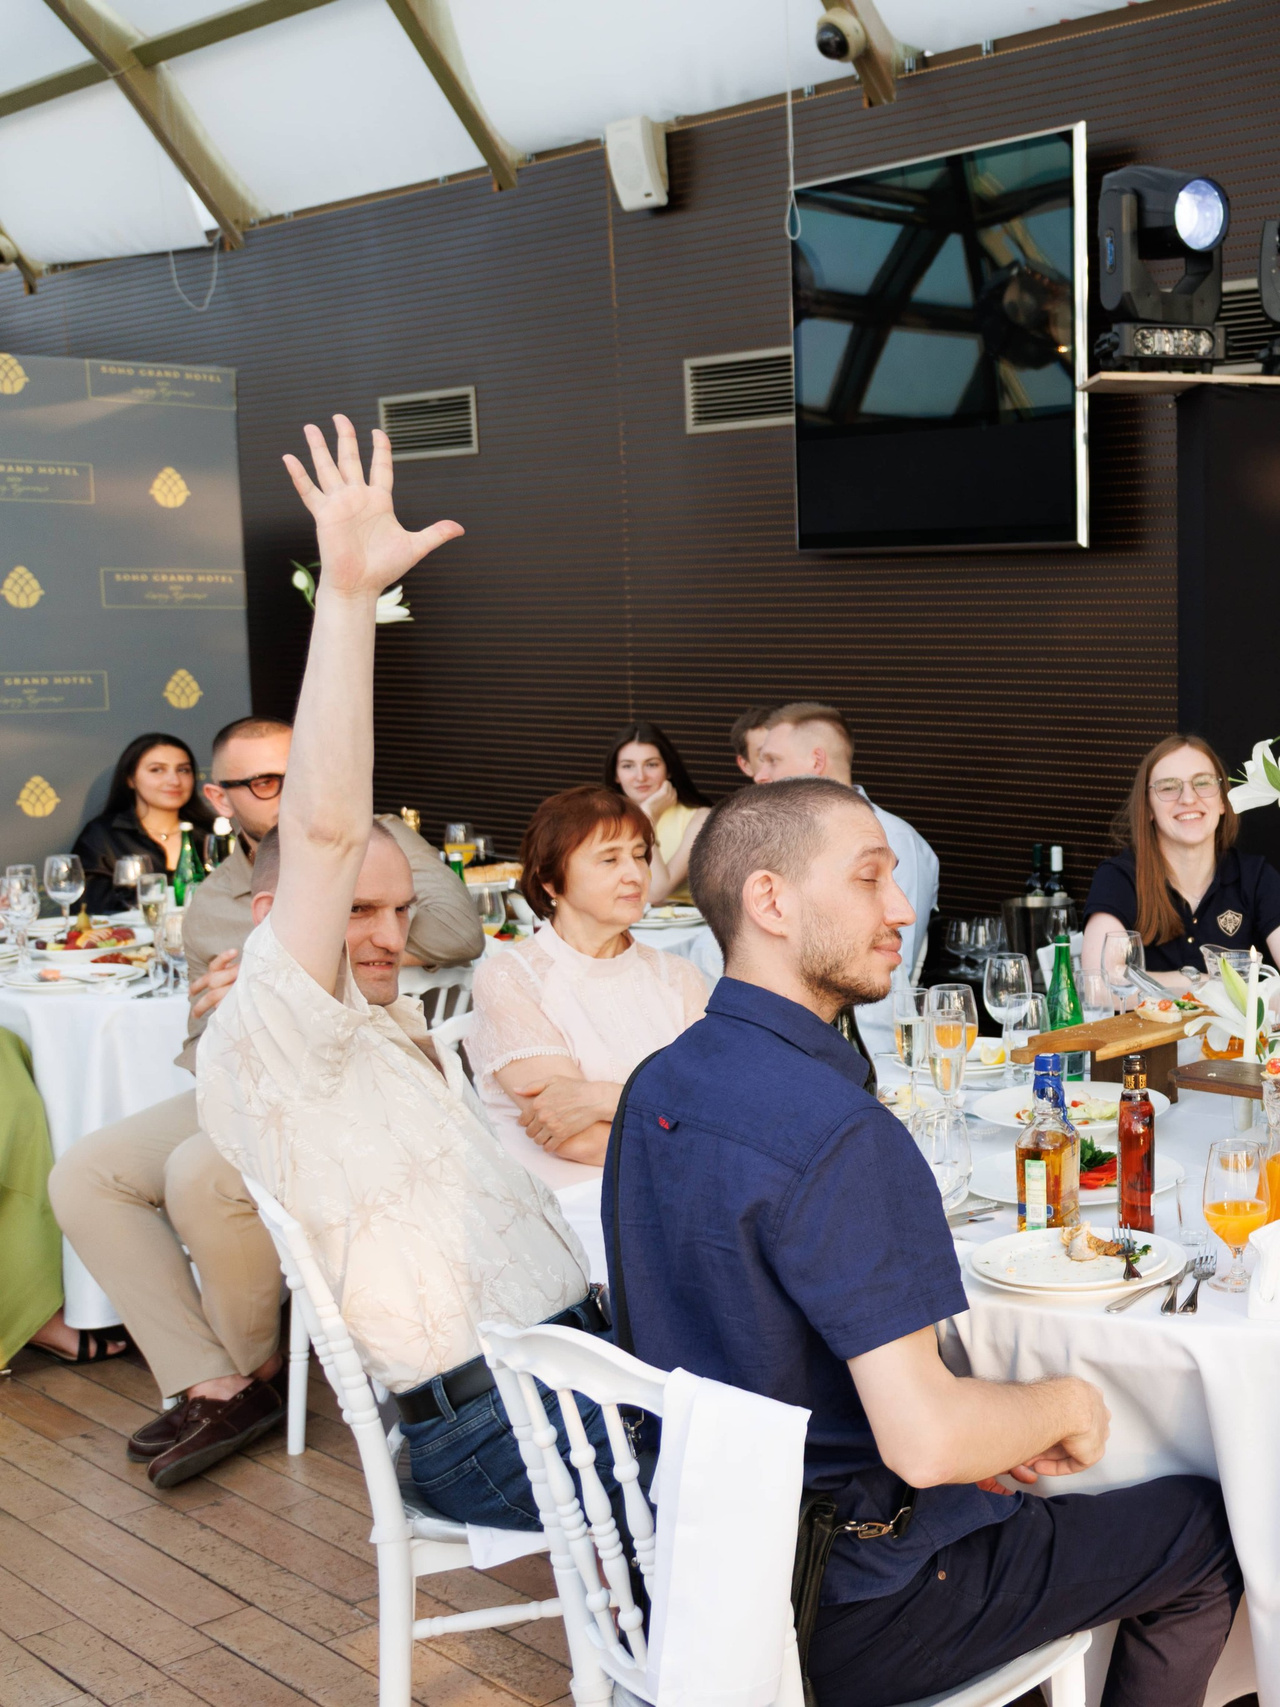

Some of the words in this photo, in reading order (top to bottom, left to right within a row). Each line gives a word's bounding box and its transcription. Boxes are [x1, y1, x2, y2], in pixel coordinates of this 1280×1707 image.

[138, 368, 181, 379] GRAND
[184, 371, 222, 383] HOTEL
[37, 466, 79, 476] HOTEL
[152, 573, 194, 583] GRAND
[197, 573, 235, 584] HOTEL
[4, 676, 49, 686] GRAND
[53, 676, 93, 686] HOTEL
